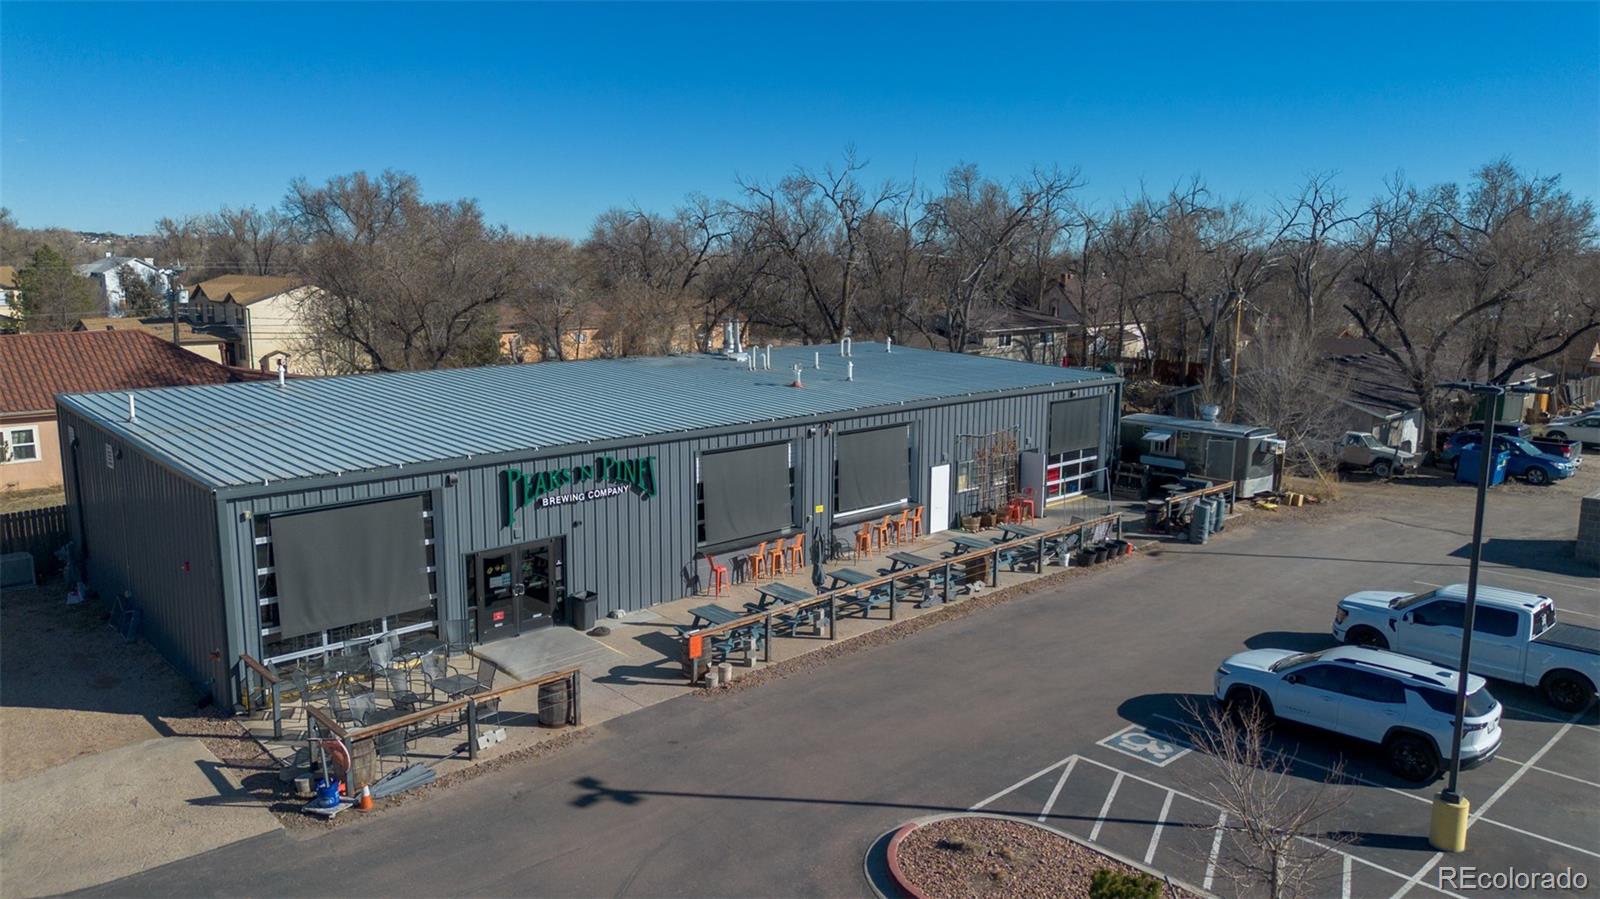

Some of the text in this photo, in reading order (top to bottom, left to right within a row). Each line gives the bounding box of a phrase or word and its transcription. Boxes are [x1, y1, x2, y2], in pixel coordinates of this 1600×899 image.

[506, 468, 572, 528] PEAKS
[602, 456, 656, 497] PINES
[542, 484, 629, 507] BREWING COMPANY
